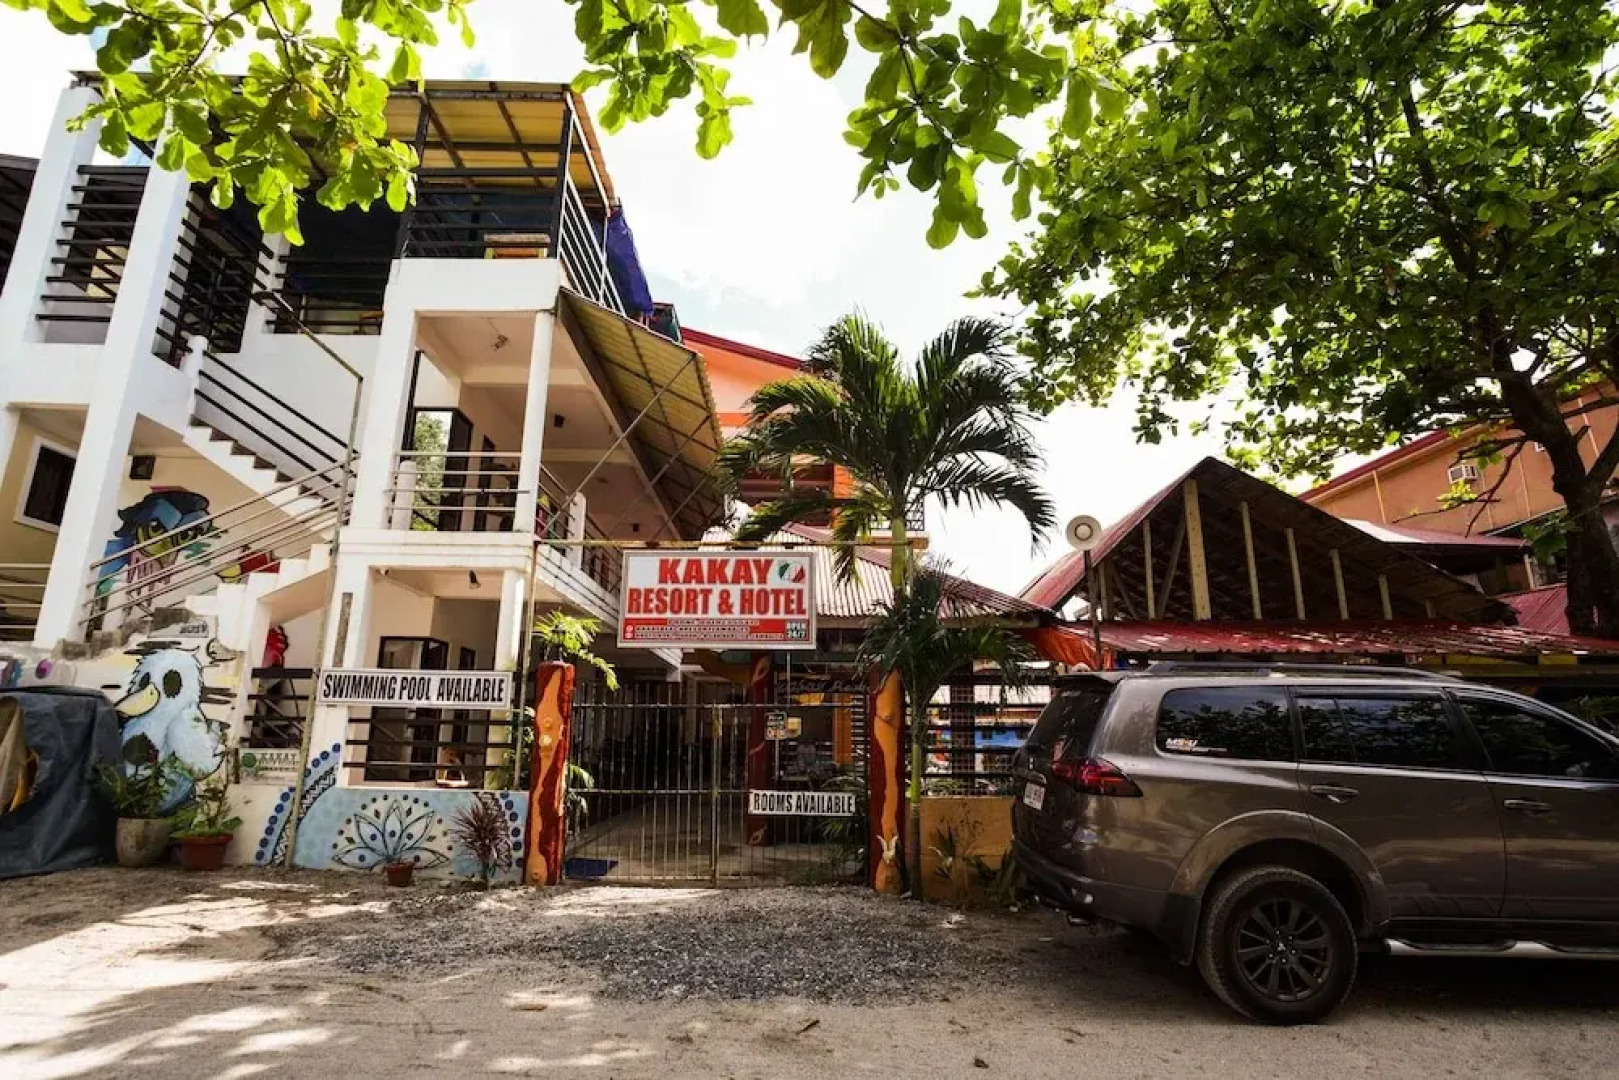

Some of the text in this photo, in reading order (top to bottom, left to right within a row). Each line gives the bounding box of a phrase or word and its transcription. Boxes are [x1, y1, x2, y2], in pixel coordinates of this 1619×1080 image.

[658, 558, 773, 584] KAKAY
[627, 587, 807, 616] RESORT & HOTEL
[323, 674, 506, 702] SWIMMING POOL AVAILABLE
[753, 792, 853, 814] ROOMS AVAILABLE
